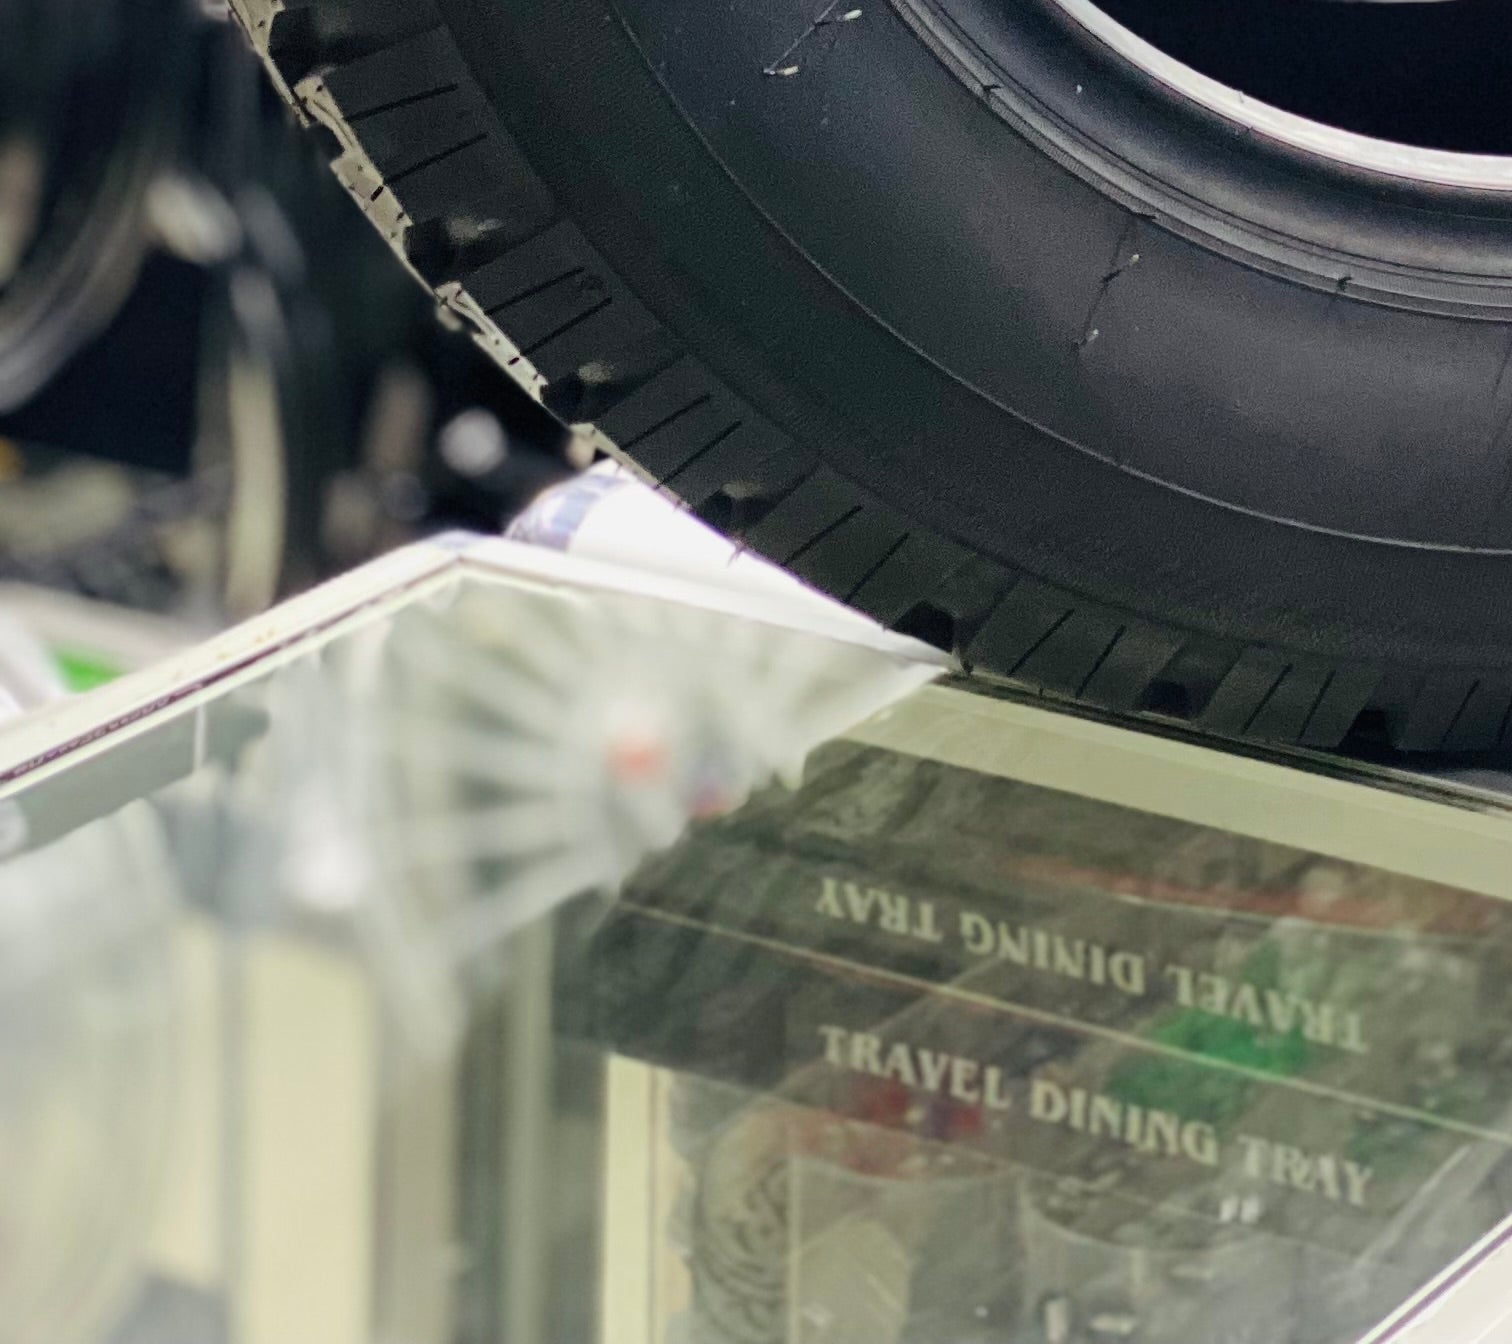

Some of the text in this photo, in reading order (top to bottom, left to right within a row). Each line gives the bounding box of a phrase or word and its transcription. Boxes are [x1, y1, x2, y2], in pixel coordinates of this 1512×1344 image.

[815, 876, 1369, 1053] TRAVEL DINING TRAY
[817, 1025, 1375, 1206] TRAVEL DINING TRAY
